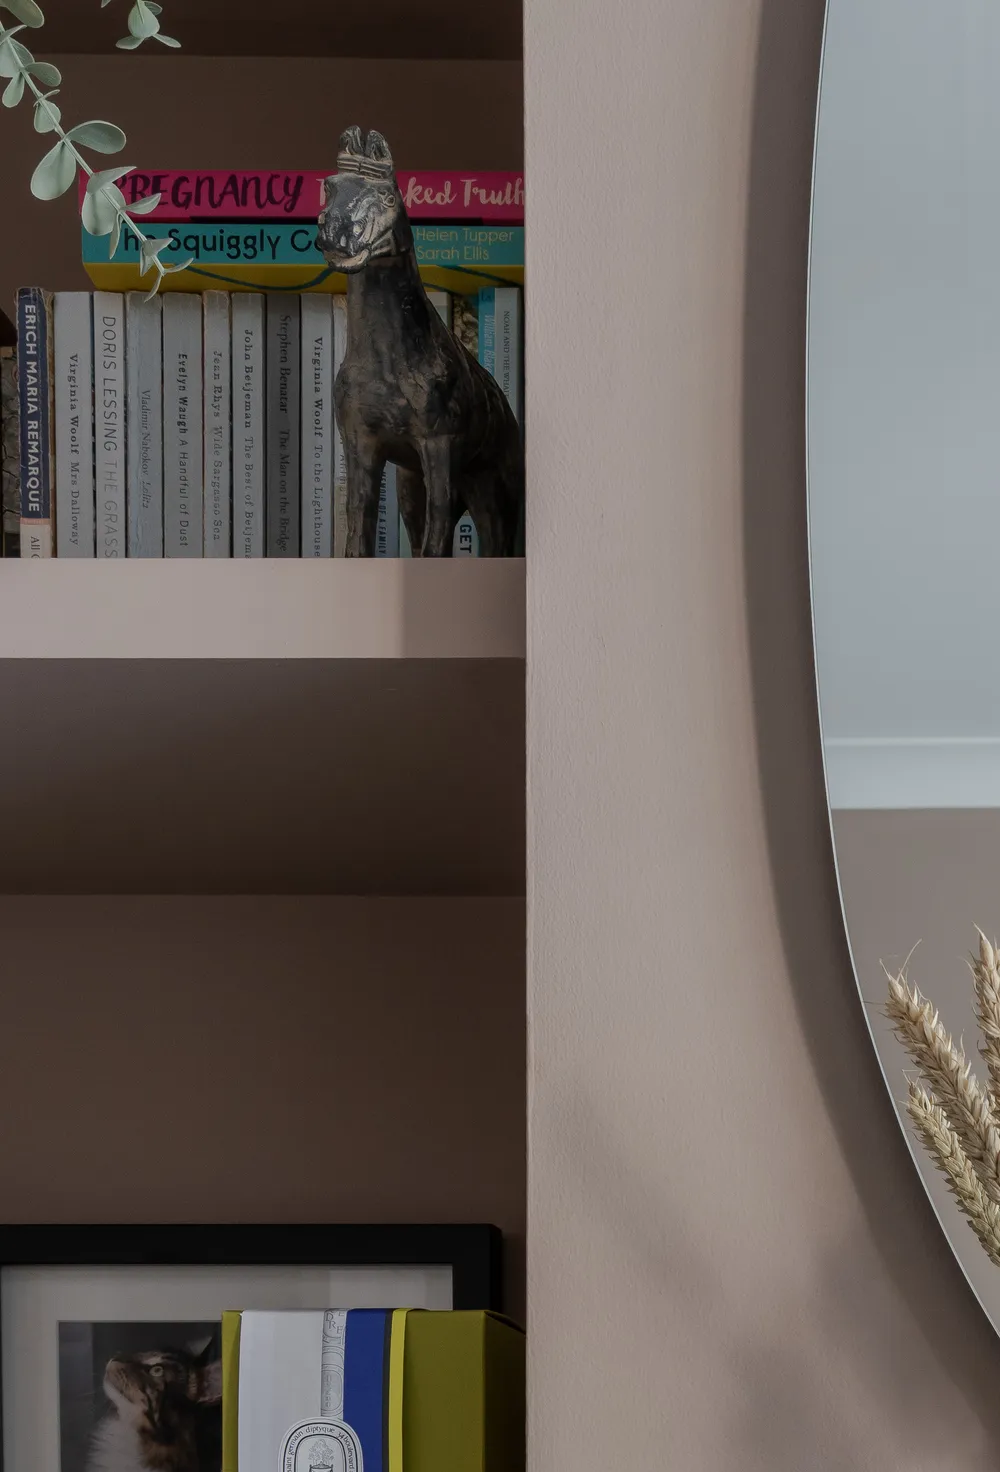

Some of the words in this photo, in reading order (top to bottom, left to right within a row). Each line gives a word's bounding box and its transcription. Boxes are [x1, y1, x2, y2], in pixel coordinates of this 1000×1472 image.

[113, 173, 304, 212] REGNANCY
[399, 177, 457, 209] ked
[167, 228, 281, 260] Squiggly
[416, 228, 458, 241] Helen
[462, 228, 514, 245] Tupper
[416, 246, 460, 260] Sarah
[464, 245, 490, 260] Ellis
[24, 304, 38, 355] ERICH
[102, 316, 117, 370] DORIS
[243, 329, 253, 361] John
[277, 315, 291, 363] Stephen
[484, 314, 497, 347] William
[177, 354, 187, 392] Evelyn
[213, 351, 222, 381] Jean
[311, 337, 322, 393] Virginia
[26, 361, 39, 415] MARIA
[67, 354, 79, 411] Virginia
[242, 365, 253, 429] Betjeman
[279, 367, 291, 414] Benatar
[103, 378, 117, 452] LESSING
[141, 389, 151, 430] Vladimir
[177, 396, 188, 434] Waugh
[211, 385, 222, 418] Rhys
[313, 399, 323, 438] Woolf
[70, 416, 79, 455] Woolf
[179, 439, 188, 447] A
[213, 426, 223, 456] Wide
[244, 436, 253, 459] The
[279, 429, 290, 452] The
[27, 420, 40, 512] REMARQUE
[141, 432, 151, 476] Nabokov
[279, 453, 290, 477] Man
[313, 444, 323, 460] To
[70, 461, 80, 486] Mrs
[103, 460, 118, 492] THE
[179, 452, 188, 499] Handful
[211, 460, 222, 516] Sargasso
[244, 463, 253, 489] Best
[279, 480, 287, 494] on
[313, 463, 323, 482] the
[141, 481, 151, 509] Lolita
[179, 503, 188, 515] of
[244, 494, 253, 507] of
[279, 497, 289, 514] the
[378, 505, 387, 515] OF
[70, 490, 80, 545] Dalloway
[104, 501, 118, 558] GRASS
[179, 520, 189, 547] Dust
[213, 519, 222, 541] Sea
[312, 487, 323, 557] Lighthouse
[31, 536, 40, 550] All
[277, 518, 290, 552] Bridge
[378, 526, 387, 554] FAMILY
[460, 524, 472, 554] GET
[288, 1431, 304, 1456] germain
[305, 1425, 335, 1435] diptyque
[343, 1436, 355, 1469] boulevard
